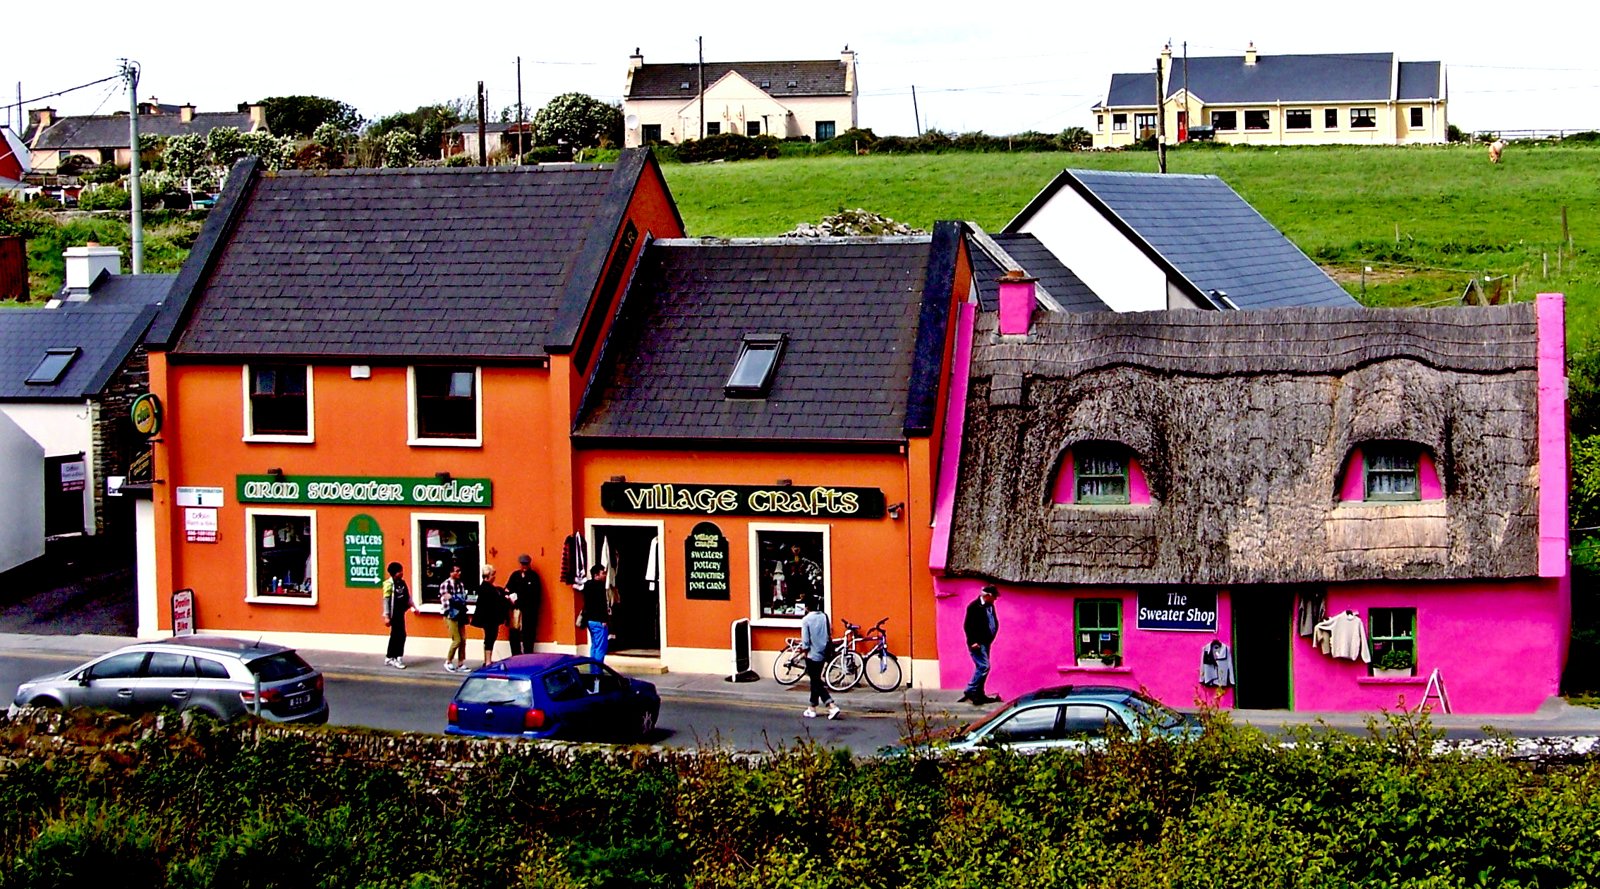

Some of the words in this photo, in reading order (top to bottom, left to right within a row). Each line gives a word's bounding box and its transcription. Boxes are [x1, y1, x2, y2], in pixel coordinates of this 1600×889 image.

[308, 482, 404, 501] sweater
[413, 481, 483, 502] outlet
[345, 535, 383, 545] SWEATERS
[361, 546, 367, 555] &
[350, 556, 379, 566] TWEEDS
[350, 566, 379, 577] OUTLET
[1167, 592, 1187, 606] The
[1139, 607, 1185, 621] Sweater
[1186, 608, 1215, 625] Shop
